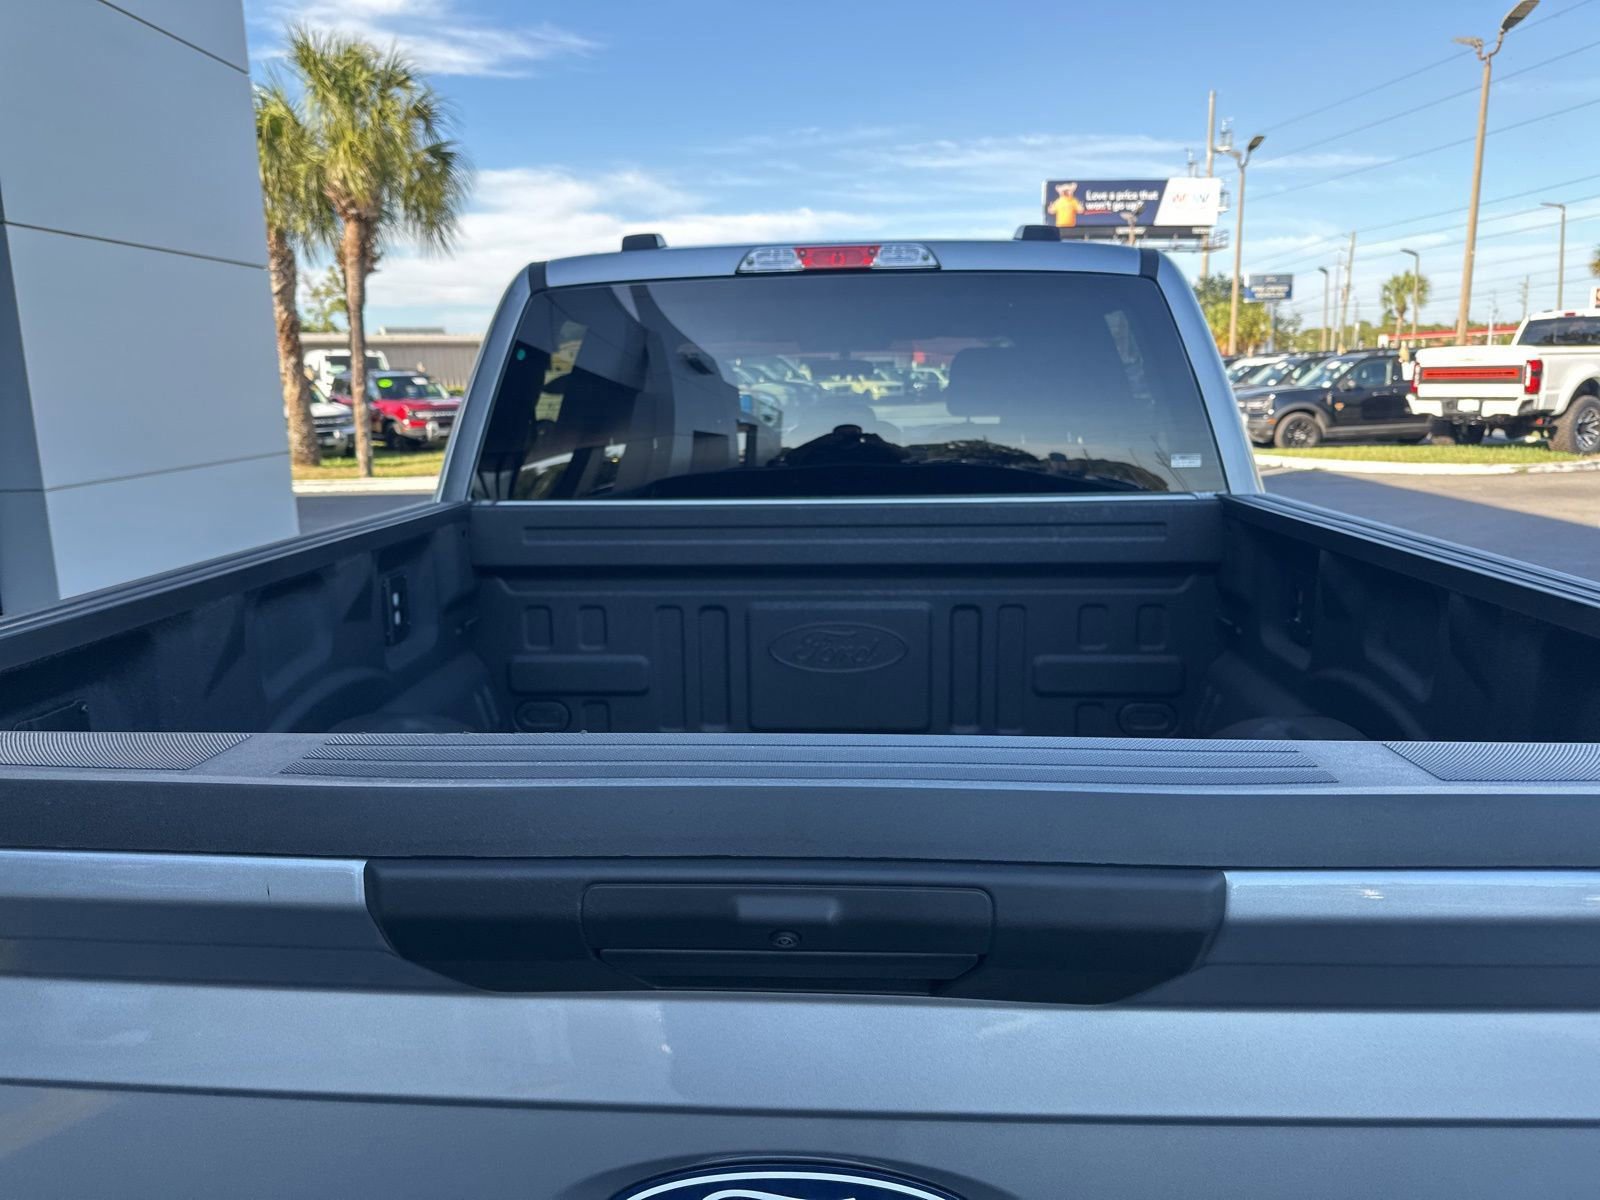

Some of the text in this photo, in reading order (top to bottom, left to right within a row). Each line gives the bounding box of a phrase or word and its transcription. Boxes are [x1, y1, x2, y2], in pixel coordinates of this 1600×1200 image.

[1086, 189, 1159, 201] Love a price that
[1085, 200, 1112, 211] won't
[1112, 201, 1125, 212] go
[793, 629, 880, 664] Ford
